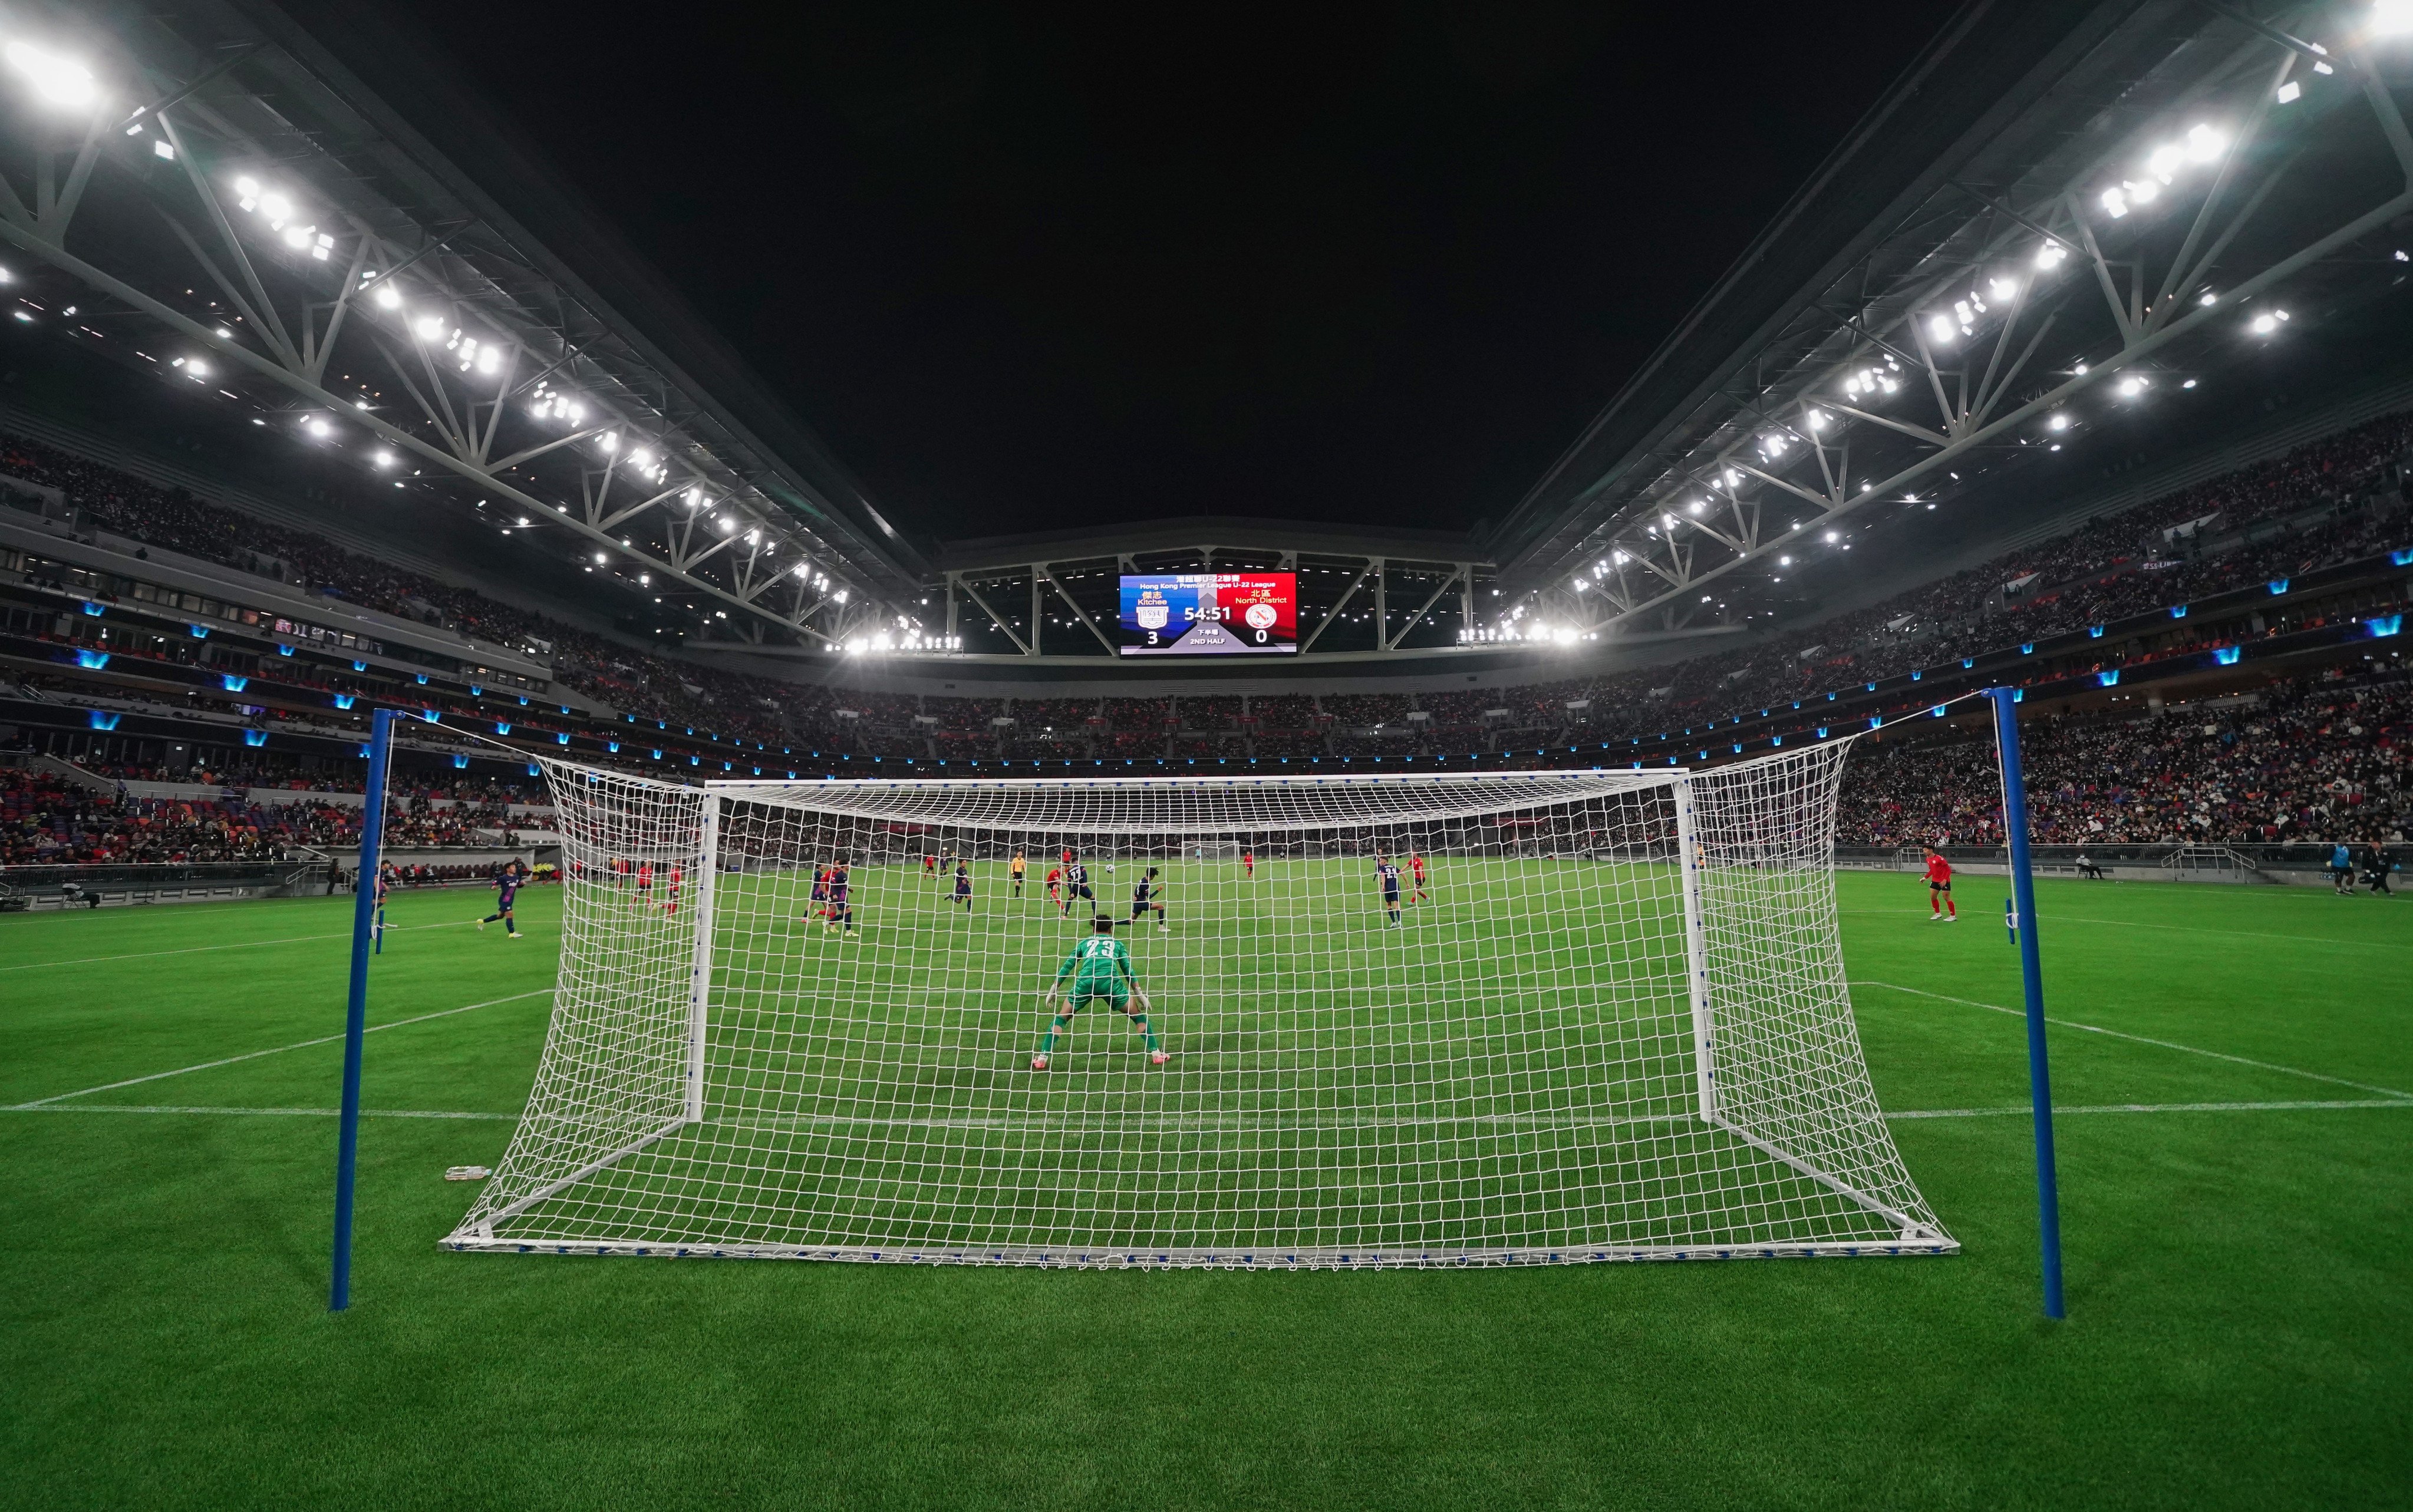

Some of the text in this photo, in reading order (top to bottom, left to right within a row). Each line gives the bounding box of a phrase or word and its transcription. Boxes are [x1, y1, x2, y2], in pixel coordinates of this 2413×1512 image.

[1142, 591, 1162, 599] 傑志
[1251, 589, 1271, 597] 北區
[1184, 606, 1230, 620] 54:51
[1148, 631, 1158, 644] 3
[1255, 629, 1267, 643] 0
[1086, 940, 1115, 958] 23
